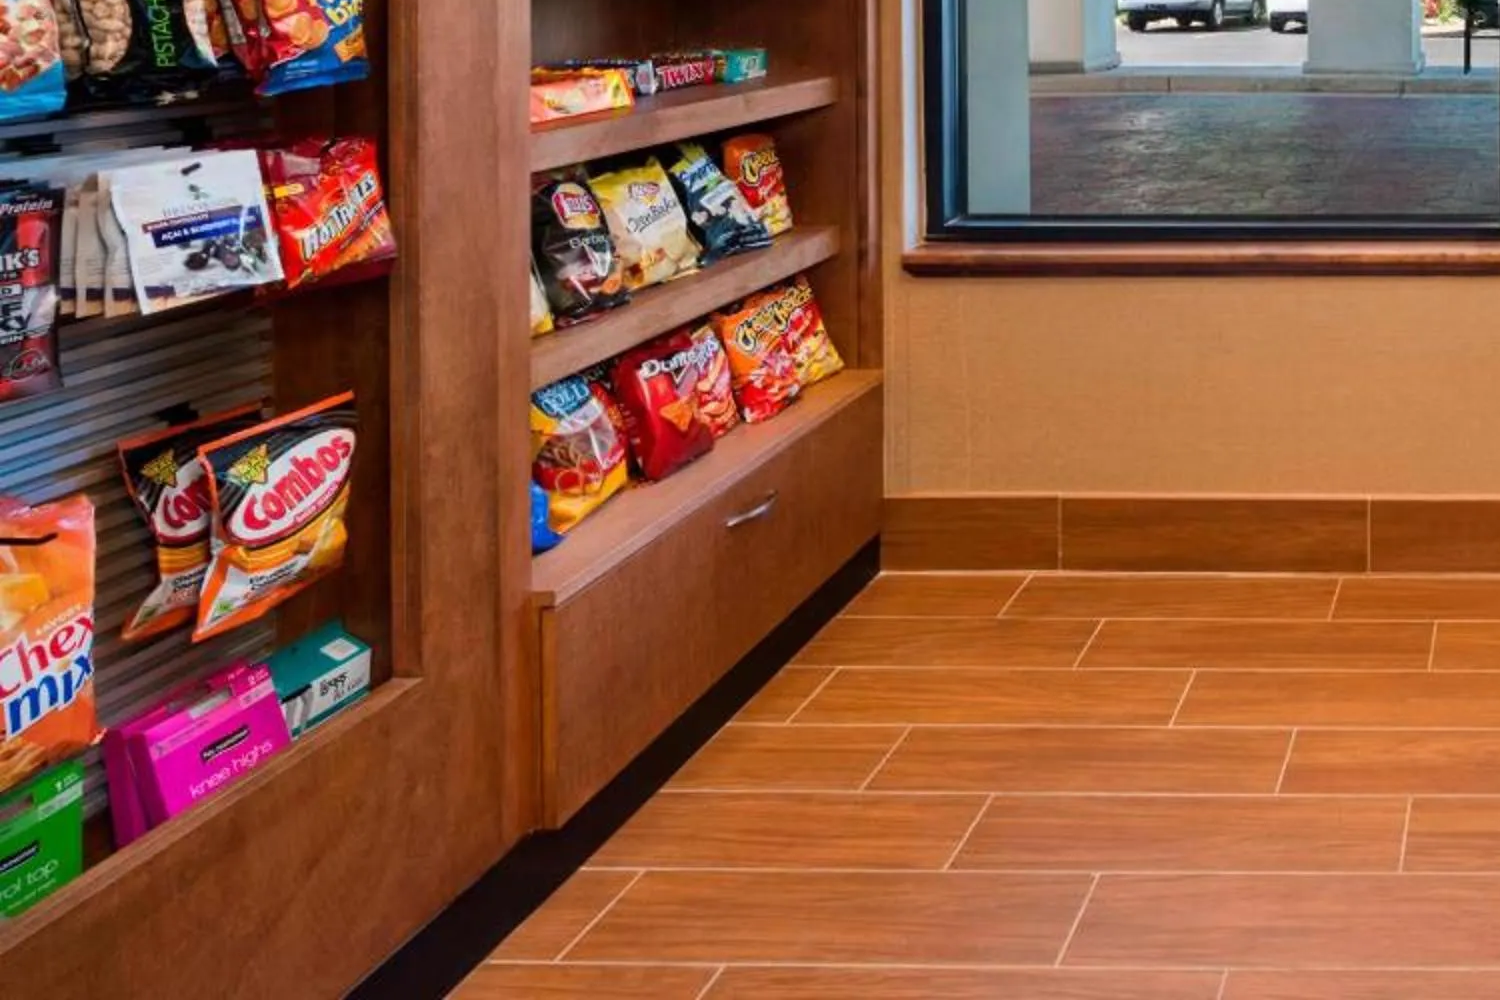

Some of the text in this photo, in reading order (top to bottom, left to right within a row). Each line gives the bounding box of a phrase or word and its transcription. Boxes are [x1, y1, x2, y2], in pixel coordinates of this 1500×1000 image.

[244, 435, 351, 530] Combos
[8, 654, 92, 735] mix
[189, 741, 273, 798] knee highs
